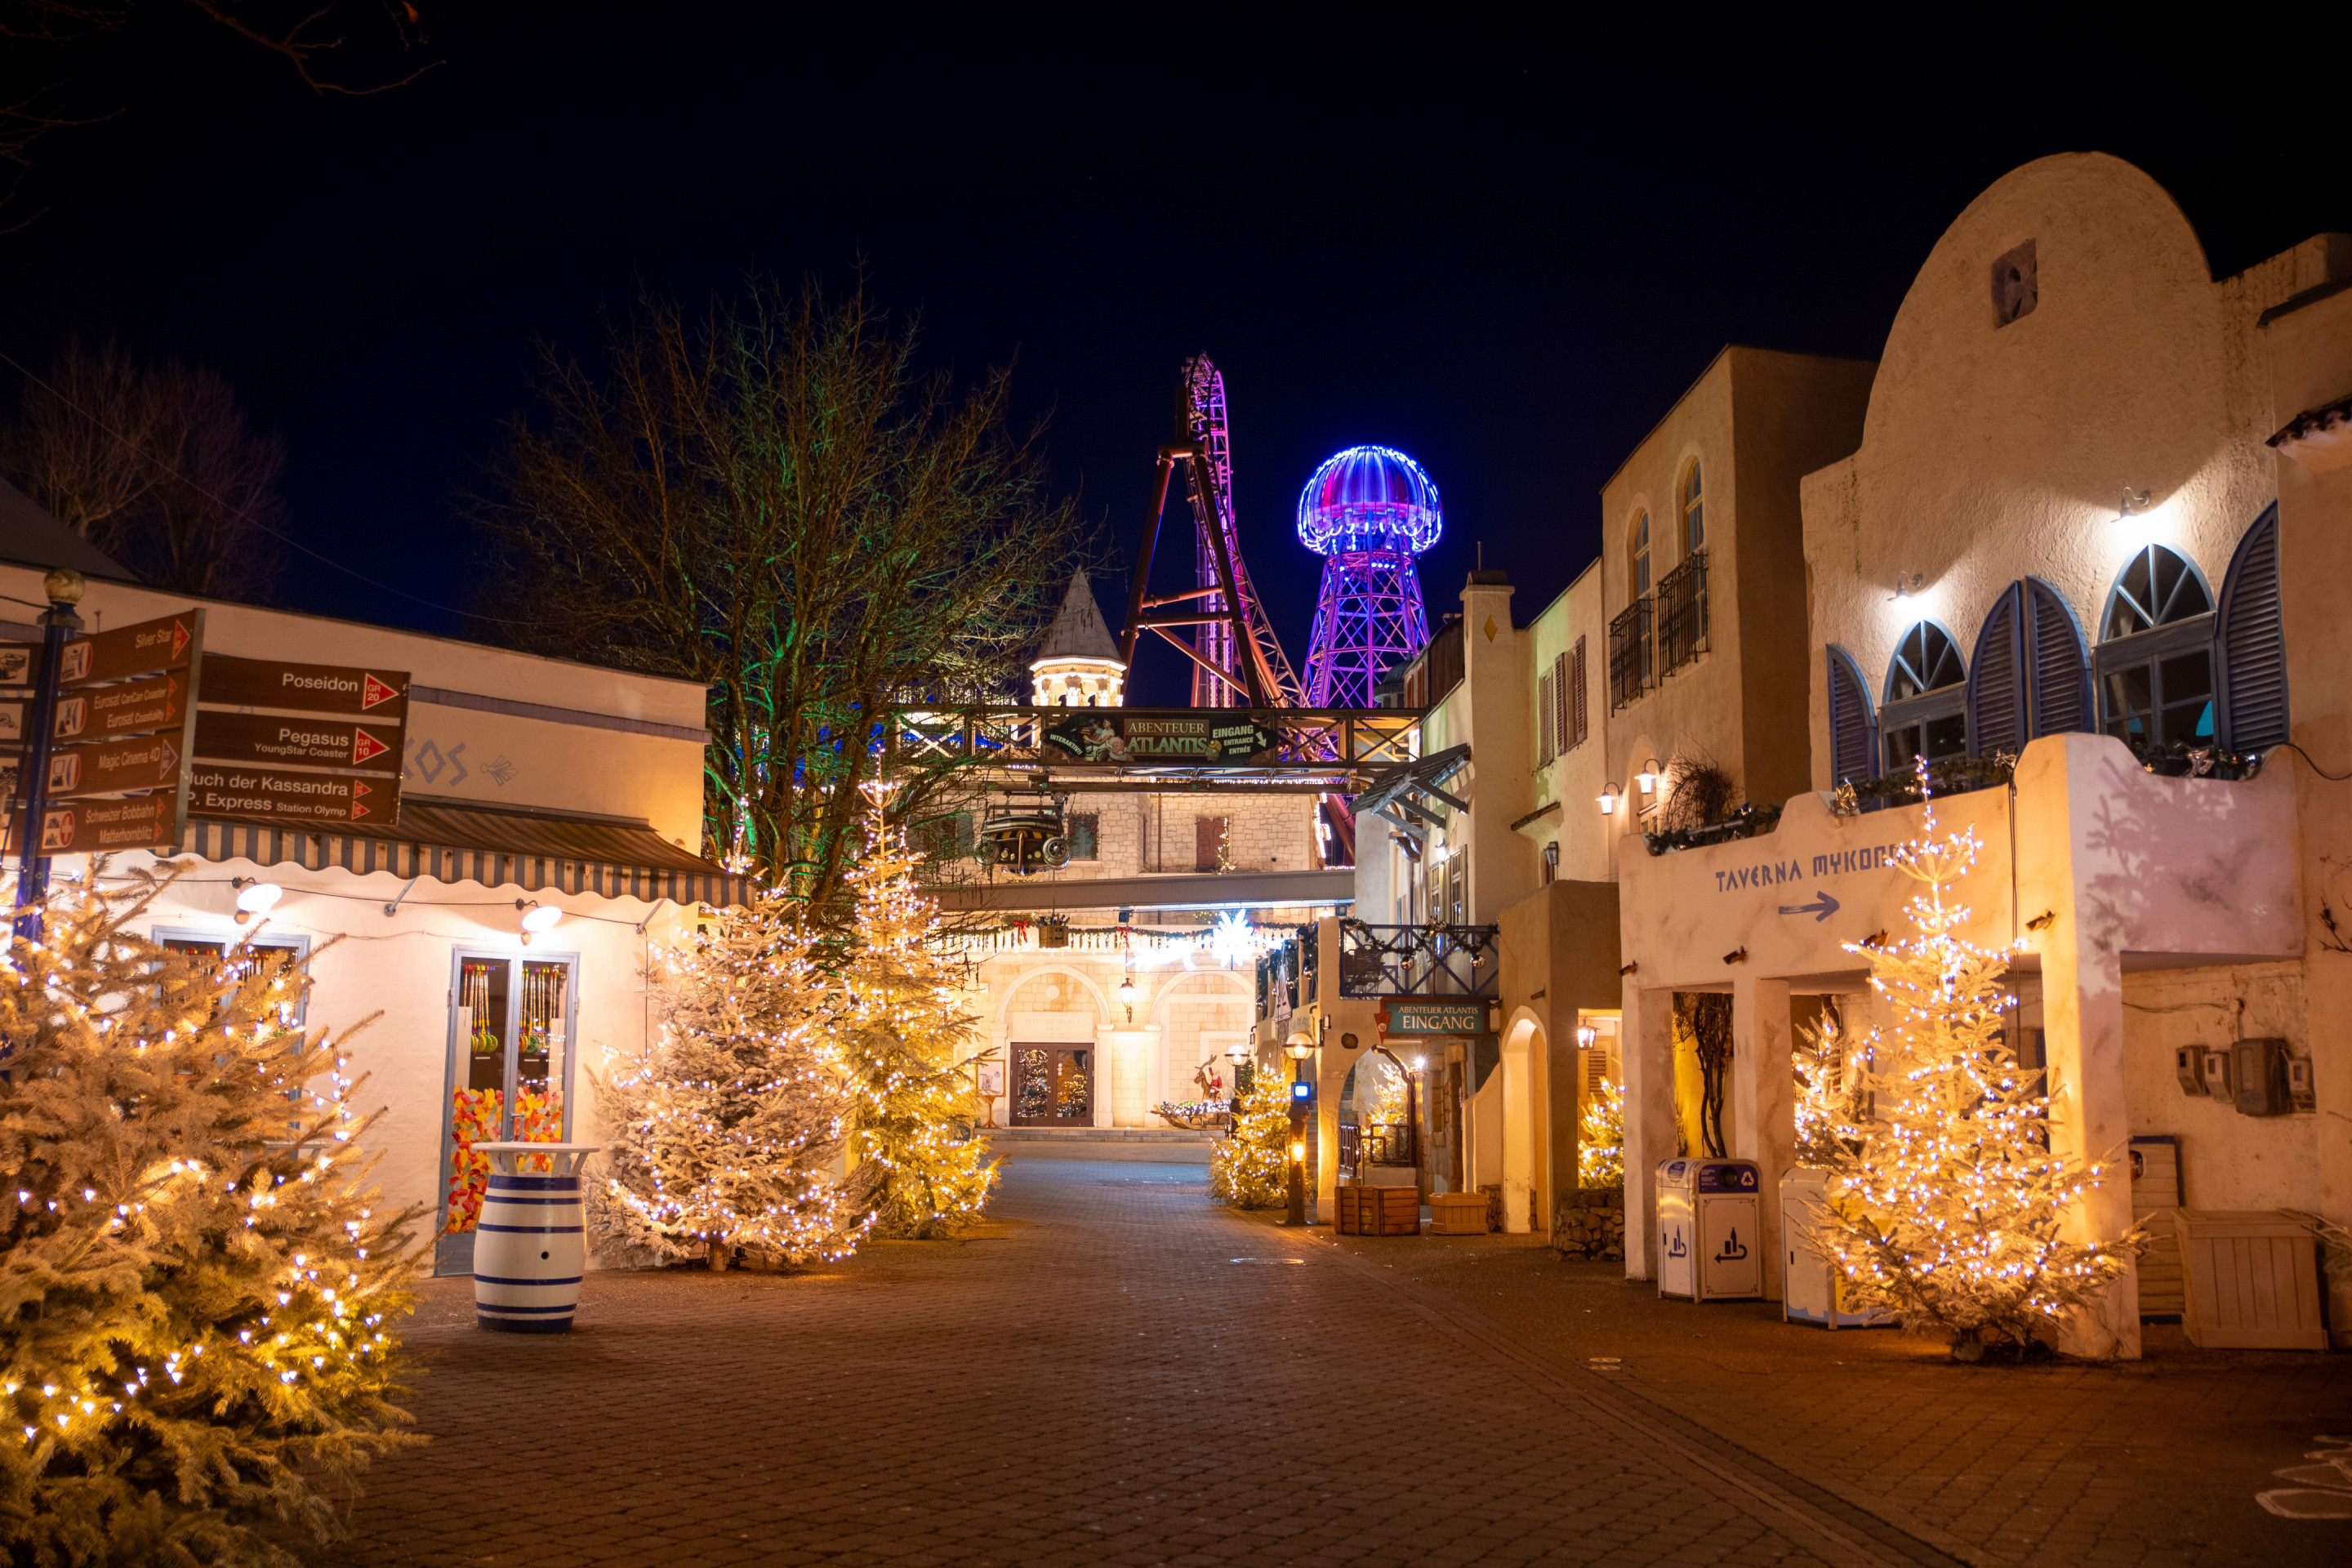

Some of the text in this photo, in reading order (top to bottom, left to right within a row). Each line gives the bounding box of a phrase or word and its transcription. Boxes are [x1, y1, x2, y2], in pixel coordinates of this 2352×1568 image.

[135, 628, 172, 649] Silver Star
[282, 672, 359, 692] Poseidon
[368, 684, 381, 693] GR
[94, 693, 120, 710] Eurosat
[144, 688, 167, 701] Coaster
[367, 693, 380, 702] 20
[107, 711, 134, 728] Eurosat
[1129, 722, 1205, 733] ABENTEUER
[278, 728, 349, 746] Pegasus
[1212, 724, 1254, 739] EINGANG
[358, 738, 371, 746] GR
[1126, 736, 1208, 754] ATLANTIS
[1223, 737, 1254, 746] ENTRANCE
[99, 746, 161, 772] Magic Cinema 4D
[255, 742, 349, 759] YoungStar Coaster
[358, 747, 369, 756] 10
[1228, 746, 1251, 755] ENTRÉE
[229, 775, 257, 791] der
[261, 777, 349, 796] Kassandra
[205, 792, 273, 811] Express
[276, 803, 312, 814] Station
[314, 805, 347, 817] Olymp
[86, 808, 122, 824] Schweizer
[122, 804, 154, 820] Bobbahn
[99, 826, 153, 844] Matterhornblitz
[1716, 858, 1802, 893] TAVERNA
[1398, 1006, 1479, 1014] ABENTEUER ATLANTIS
[1402, 1015, 1475, 1030] EINGANG
